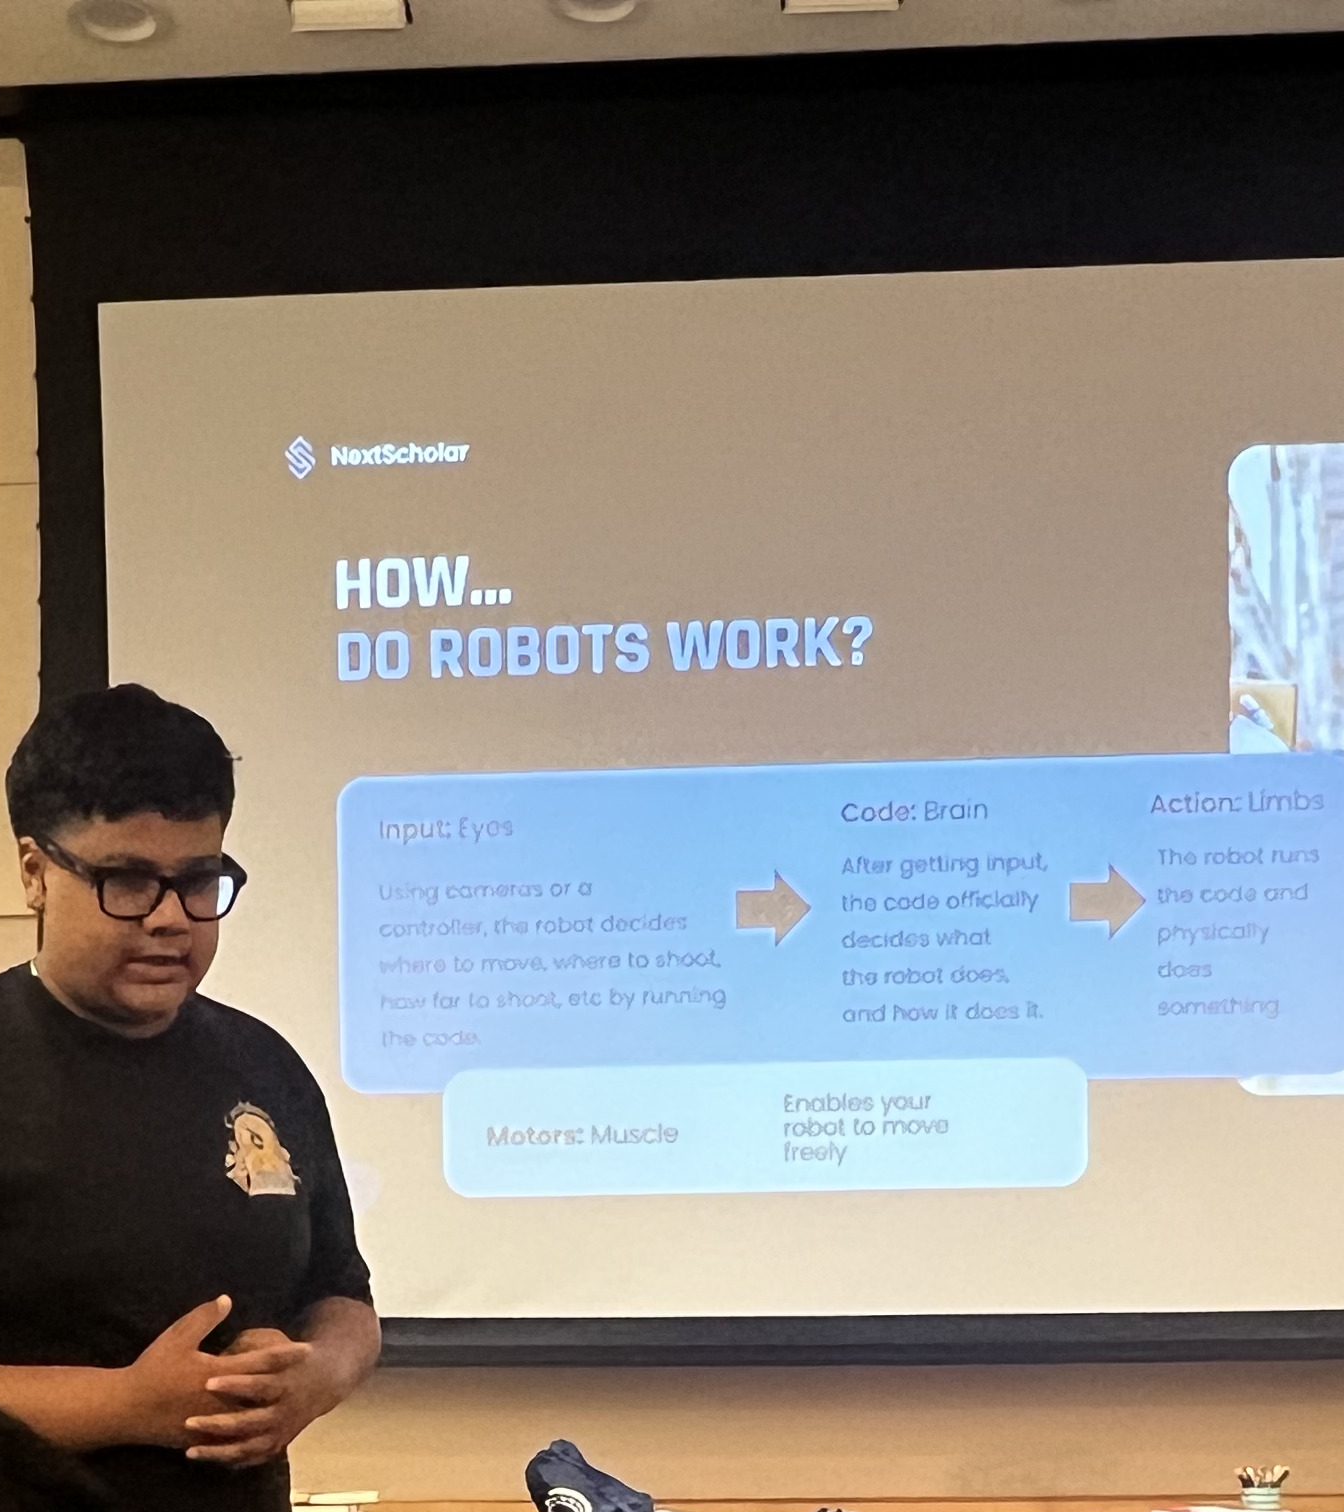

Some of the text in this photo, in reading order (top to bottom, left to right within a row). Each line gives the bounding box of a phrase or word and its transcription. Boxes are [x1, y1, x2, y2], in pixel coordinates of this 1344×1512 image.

[330, 442, 470, 466] NextScholar
[336, 555, 512, 609] HOW...
[337, 615, 874, 681] DO ROBOTS WORK?
[841, 799, 988, 823] Code: Brain
[1150, 788, 1325, 814] Action: Limbs
[379, 816, 513, 845] Input: Eyes
[841, 855, 893, 875] After
[900, 854, 979, 880] getting
[1157, 846, 1320, 866] The robot runs
[379, 881, 592, 906] Using cameras or a
[842, 889, 1039, 913] the code officially
[1157, 883, 1308, 904] the code and
[494, 915, 528, 934] the
[536, 916, 594, 934] robot
[601, 913, 687, 932] decides
[1157, 922, 1269, 947] physically
[841, 928, 992, 949] decides what
[379, 956, 446, 973] where
[454, 956, 474, 973] to
[553, 953, 621, 970] where
[629, 952, 649, 968] to
[1157, 961, 1213, 978] does
[842, 967, 878, 986] the
[884, 966, 943, 984] robot
[469, 991, 490, 1009] to
[569, 989, 602, 1007] etc
[609, 987, 635, 1010] by
[643, 987, 727, 1009] running
[843, 1003, 886, 1023] and
[892, 1003, 938, 1022] how
[946, 1002, 958, 1020] it
[965, 1001, 1019, 1020] does
[381, 1030, 417, 1048] the
[783, 1093, 932, 1117] Enables your
[486, 1122, 679, 1147] Motors: Muscle
[783, 1117, 949, 1137] robot to move
[784, 1140, 848, 1167] freely
